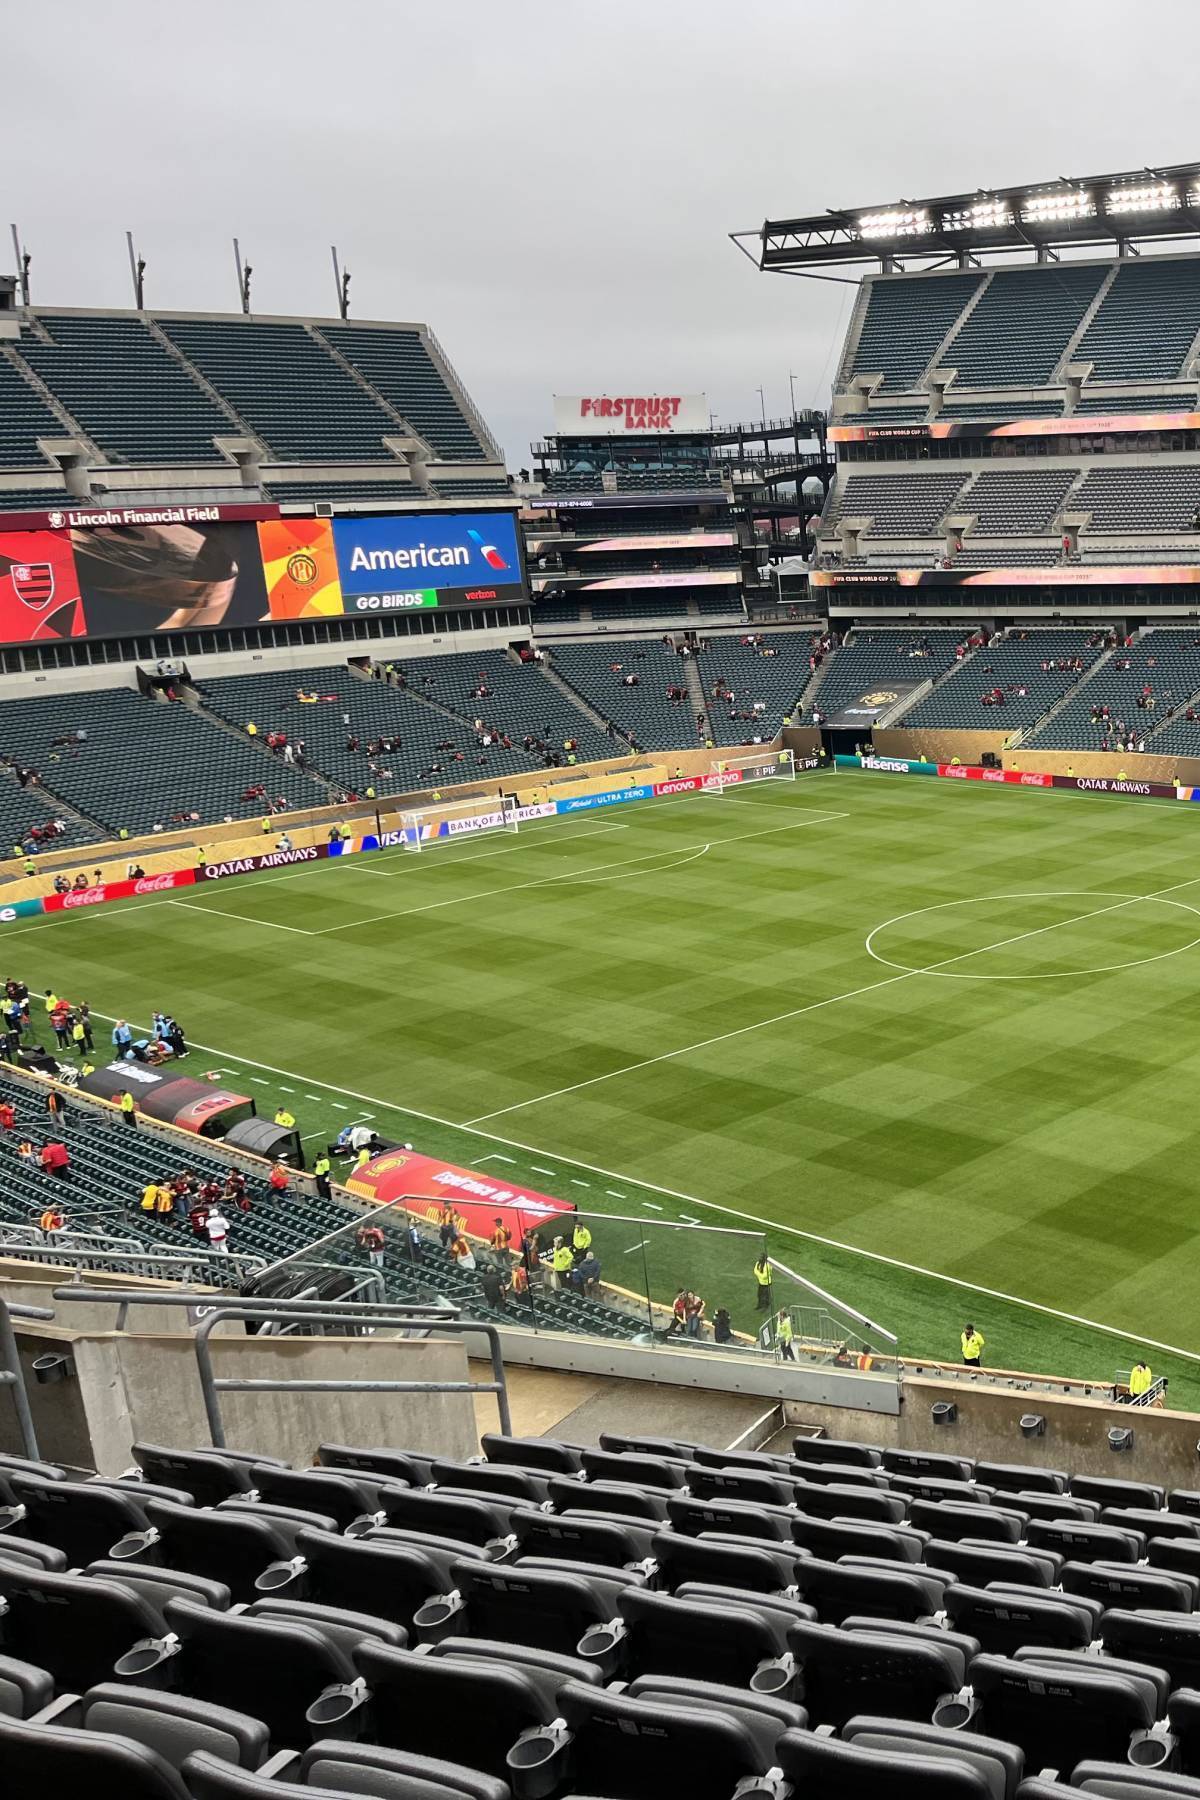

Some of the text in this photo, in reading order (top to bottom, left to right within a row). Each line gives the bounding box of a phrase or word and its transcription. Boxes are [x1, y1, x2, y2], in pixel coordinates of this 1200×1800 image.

[624, 415, 672, 429] BANK
[69, 506, 220, 526] Lincoln Financial Field
[350, 543, 470, 571] American
[356, 593, 423, 610] GO BIRDS
[464, 590, 496, 601] verizon
[762, 766, 776, 776] PIF
[805, 759, 818, 769] PIF
[861, 756, 909, 772] Hisense
[701, 772, 739, 787] Lenovo
[945, 766, 967, 778] Coca-Cola
[982, 770, 1005, 782] Coca-Cola
[1020, 773, 1044, 786] Coca-Cola
[656, 779, 694, 794] Lenovo
[1076, 778, 1151, 794] QATAR AIRWAYS
[597, 793, 621, 804] ULTRA
[623, 788, 644, 800] ZERO
[450, 819, 479, 831] BANK
[481, 816, 493, 826] OF
[373, 830, 408, 848] VISA
[205, 846, 319, 878] QATAR AIRWAYS
[134, 874, 174, 893] Coca-Cola
[63, 887, 105, 908] Coca-Cola
